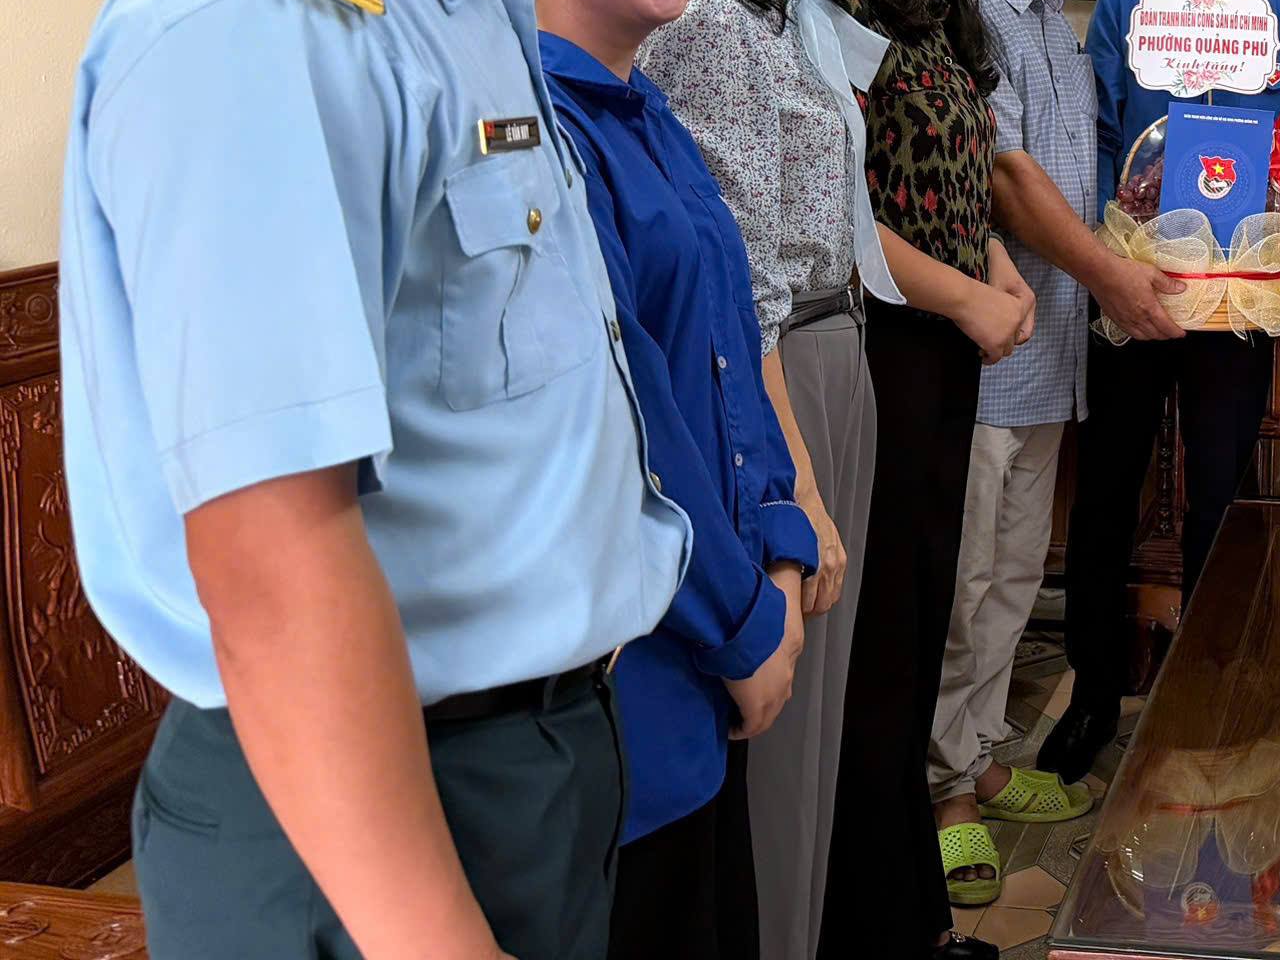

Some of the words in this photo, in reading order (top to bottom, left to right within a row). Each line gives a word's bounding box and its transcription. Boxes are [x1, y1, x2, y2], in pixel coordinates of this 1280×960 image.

[1159, 11, 1180, 27] THANH
[1251, 15, 1268, 32] MINH
[1138, 32, 1191, 52] PHƯỜNG
[1195, 33, 1239, 55] QUẢNG
[1242, 38, 1268, 57] PHÚ
